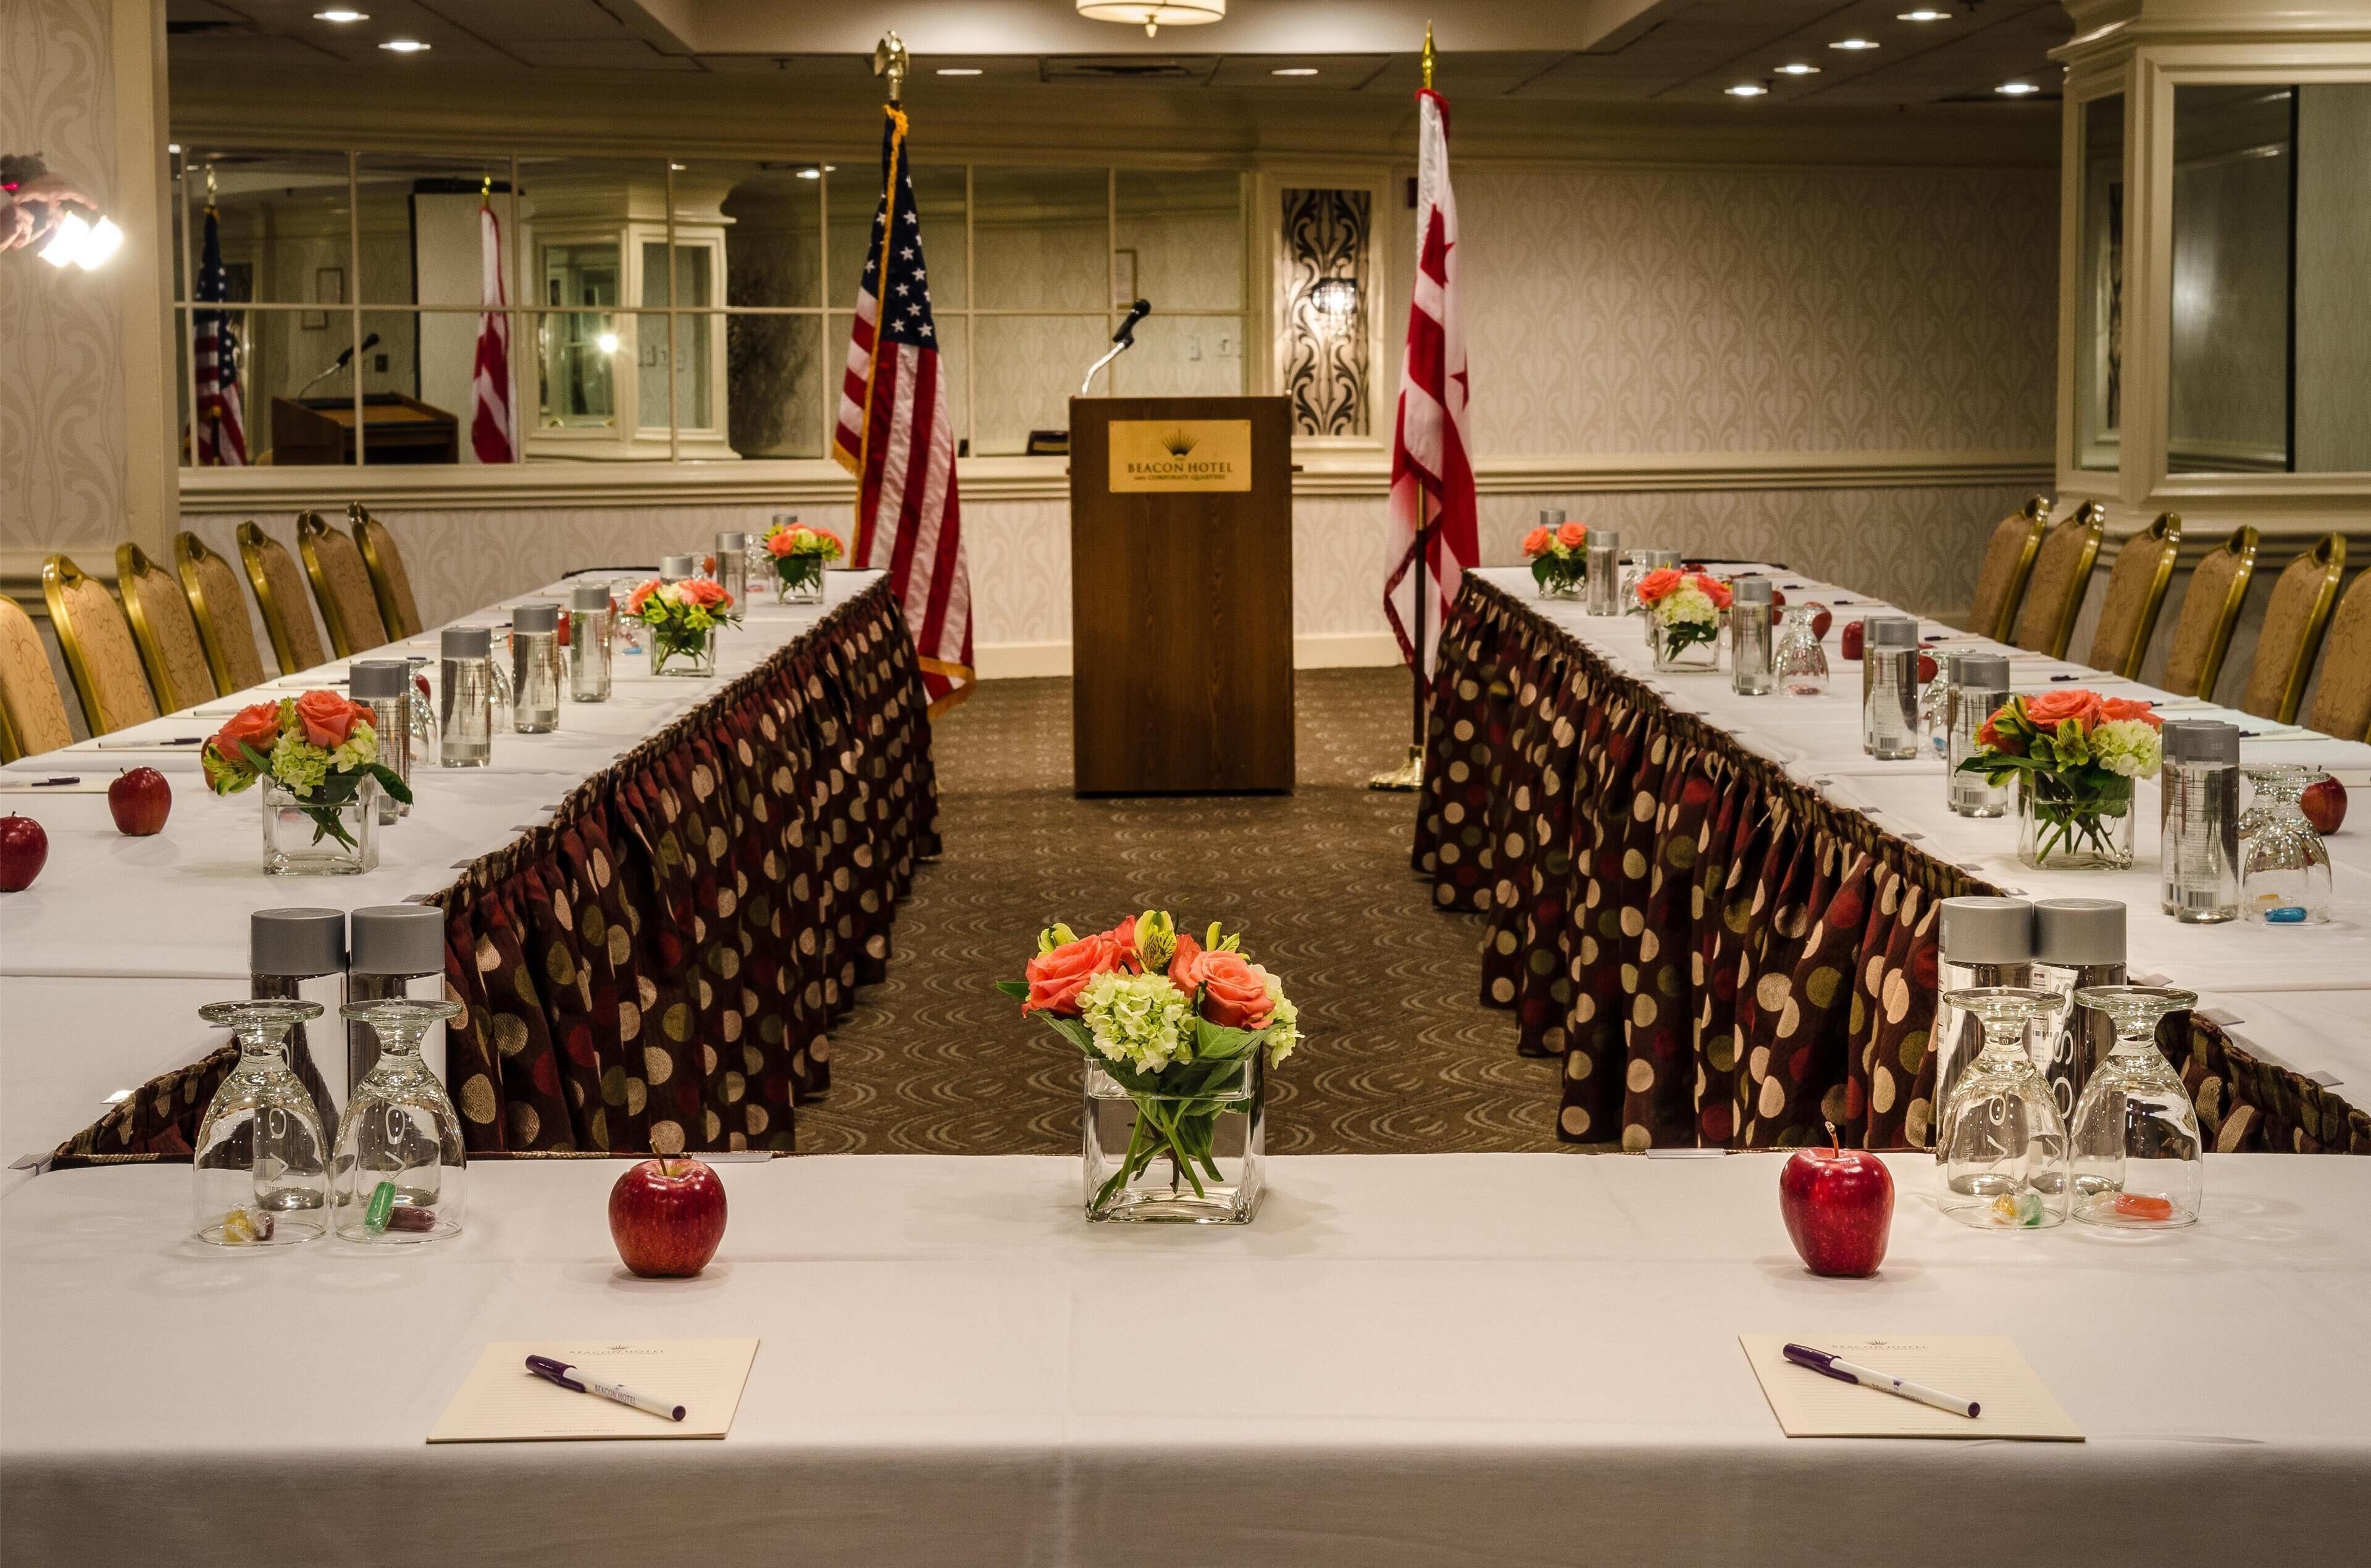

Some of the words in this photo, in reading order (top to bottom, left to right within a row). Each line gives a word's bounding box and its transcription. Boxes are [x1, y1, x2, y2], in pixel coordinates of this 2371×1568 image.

[1127, 463, 1184, 473] BEACON
[1188, 462, 1233, 472] HOTEL
[595, 1384, 617, 1398] BEACON
[617, 1391, 637, 1406] HOTEL
